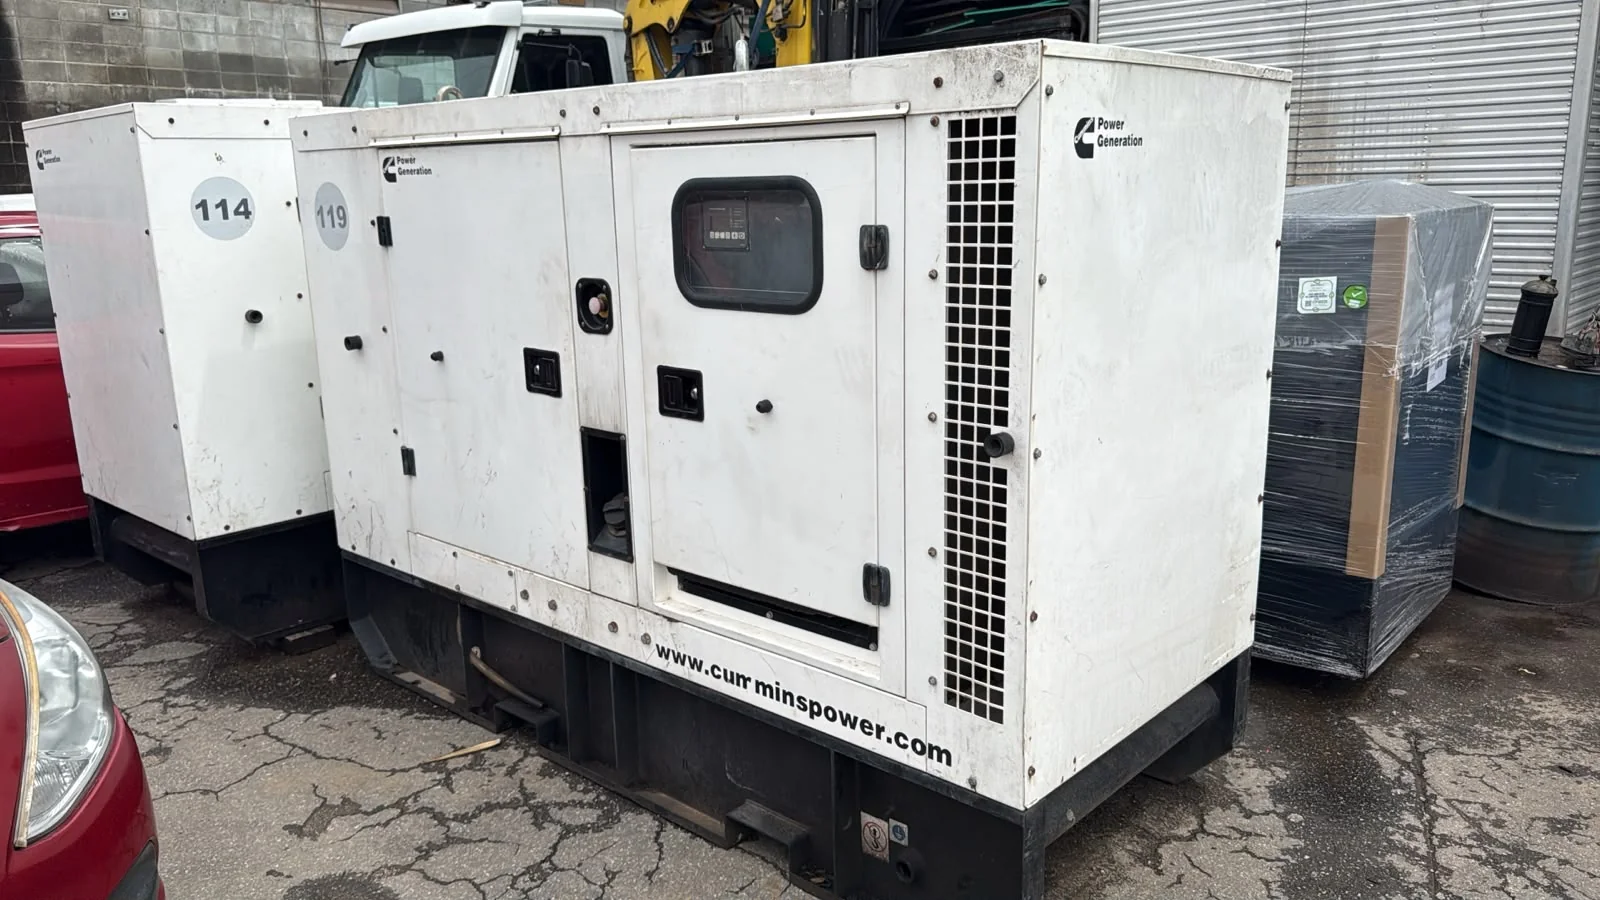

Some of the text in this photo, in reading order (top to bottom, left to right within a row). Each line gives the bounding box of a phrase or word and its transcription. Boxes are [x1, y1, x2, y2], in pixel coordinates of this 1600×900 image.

[1098, 117, 1124, 130] Power
[1097, 134, 1142, 147] Generation
[397, 156, 416, 165] Power
[398, 166, 432, 175] Generation
[195, 198, 252, 221] 114
[317, 205, 347, 229] 119
